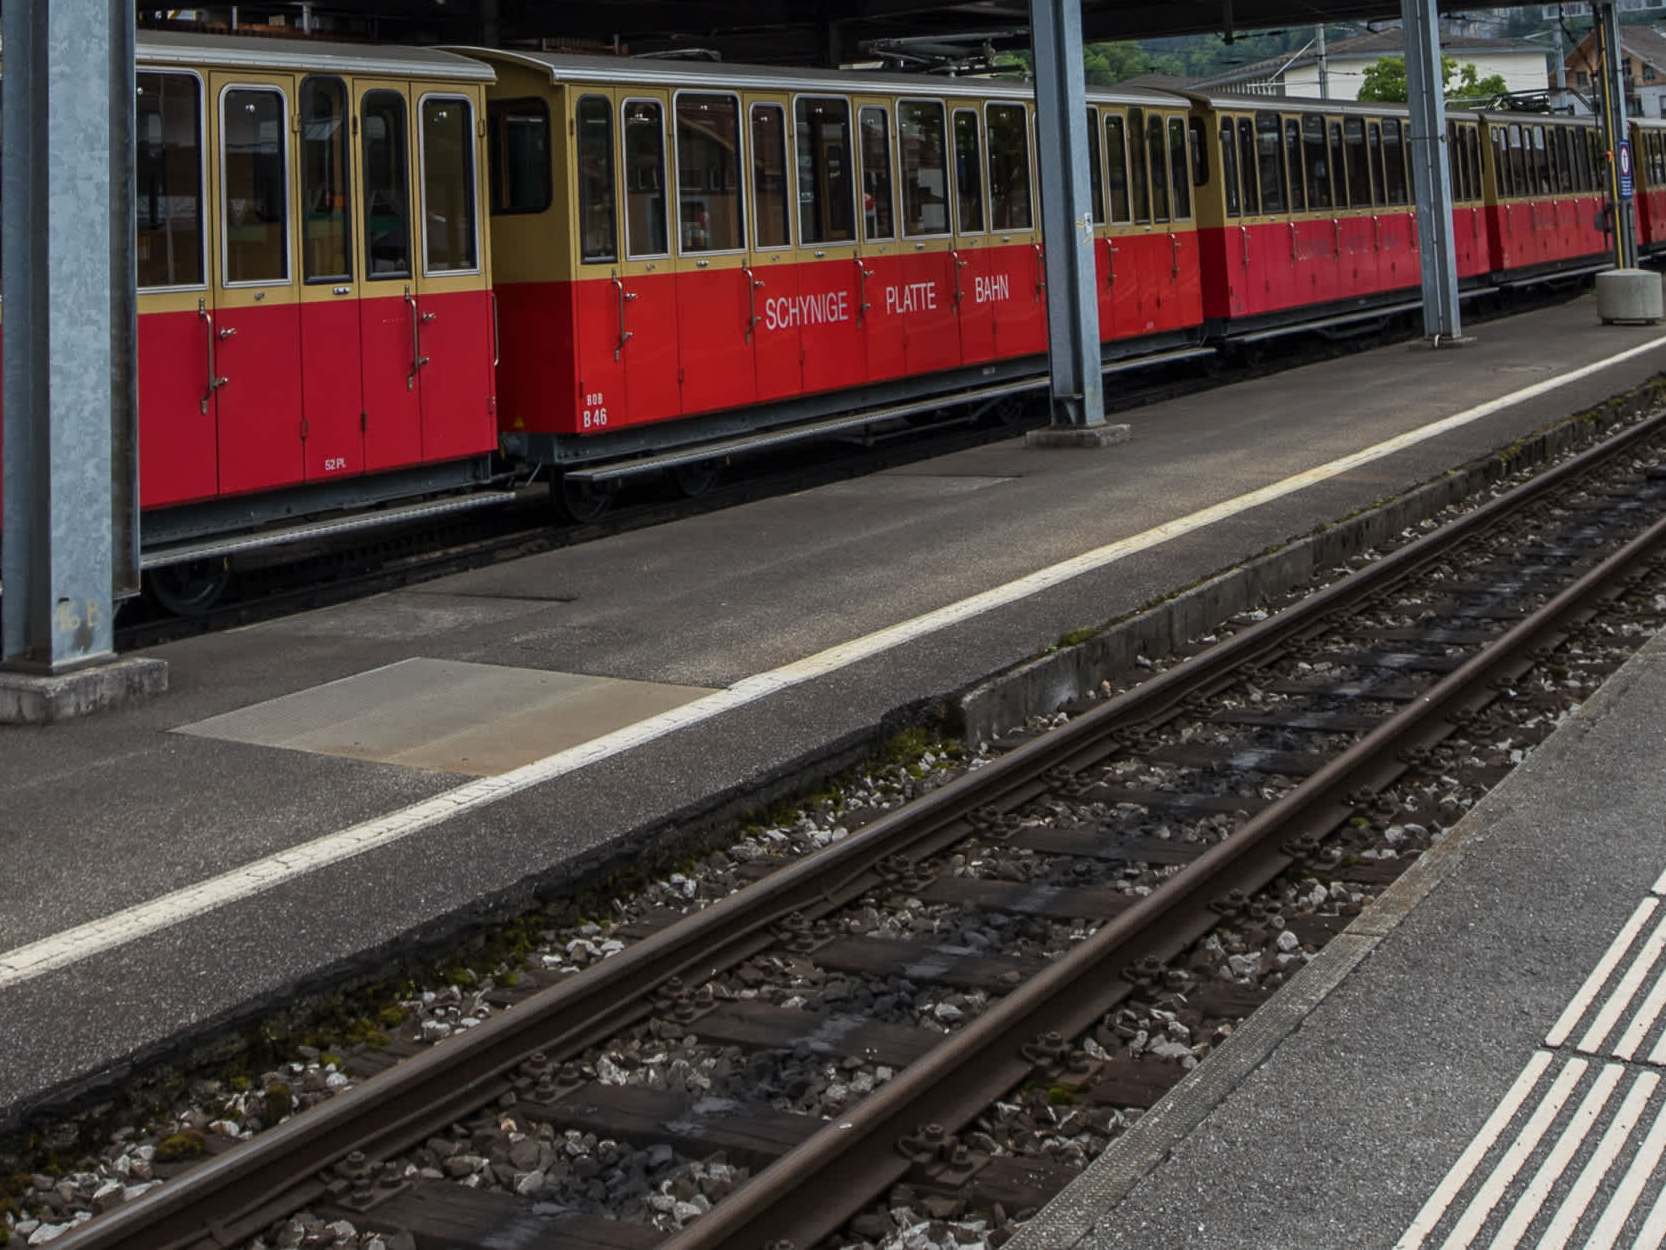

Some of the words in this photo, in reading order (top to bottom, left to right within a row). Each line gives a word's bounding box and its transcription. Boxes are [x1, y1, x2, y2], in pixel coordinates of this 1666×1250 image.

[765, 291, 849, 331] SCHYNIGE
[885, 281, 937, 315] PLATTE
[974, 274, 1010, 303] BAHN
[587, 393, 603, 406] BOB
[583, 410, 592, 428] B
[593, 407, 607, 427] 46
[324, 458, 336, 471] 52
